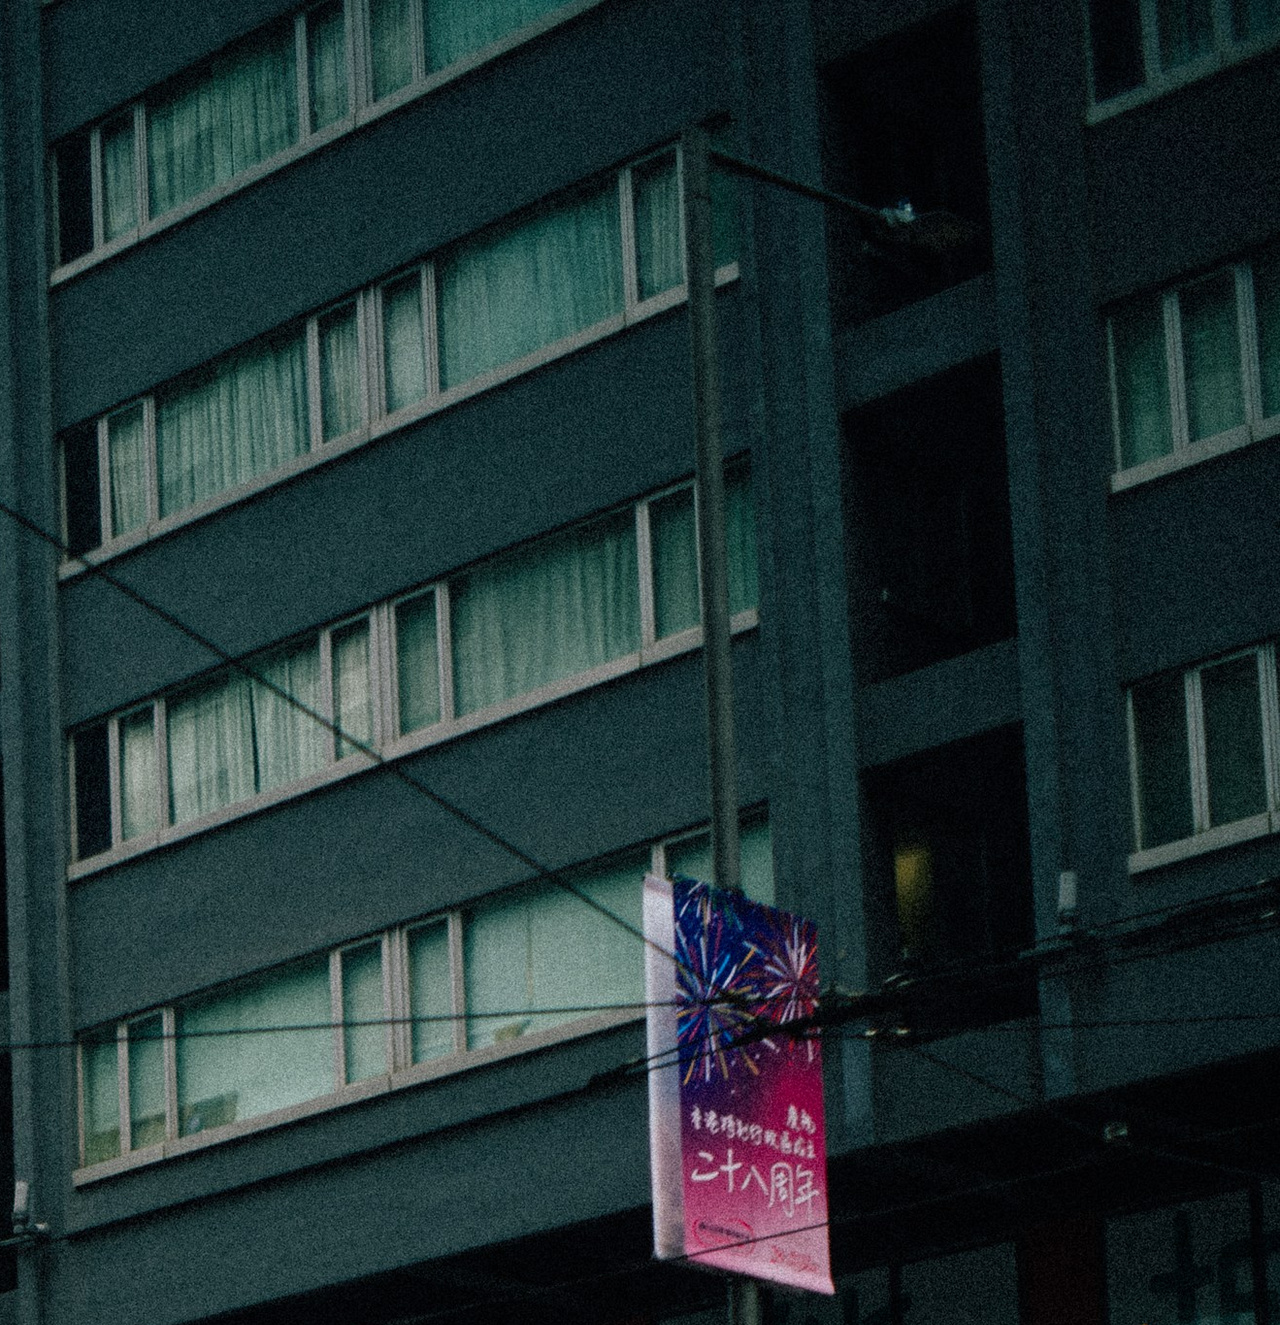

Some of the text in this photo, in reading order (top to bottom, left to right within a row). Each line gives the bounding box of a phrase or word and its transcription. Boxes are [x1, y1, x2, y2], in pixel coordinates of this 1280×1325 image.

[690, 1148, 820, 1223] 二十八周年
